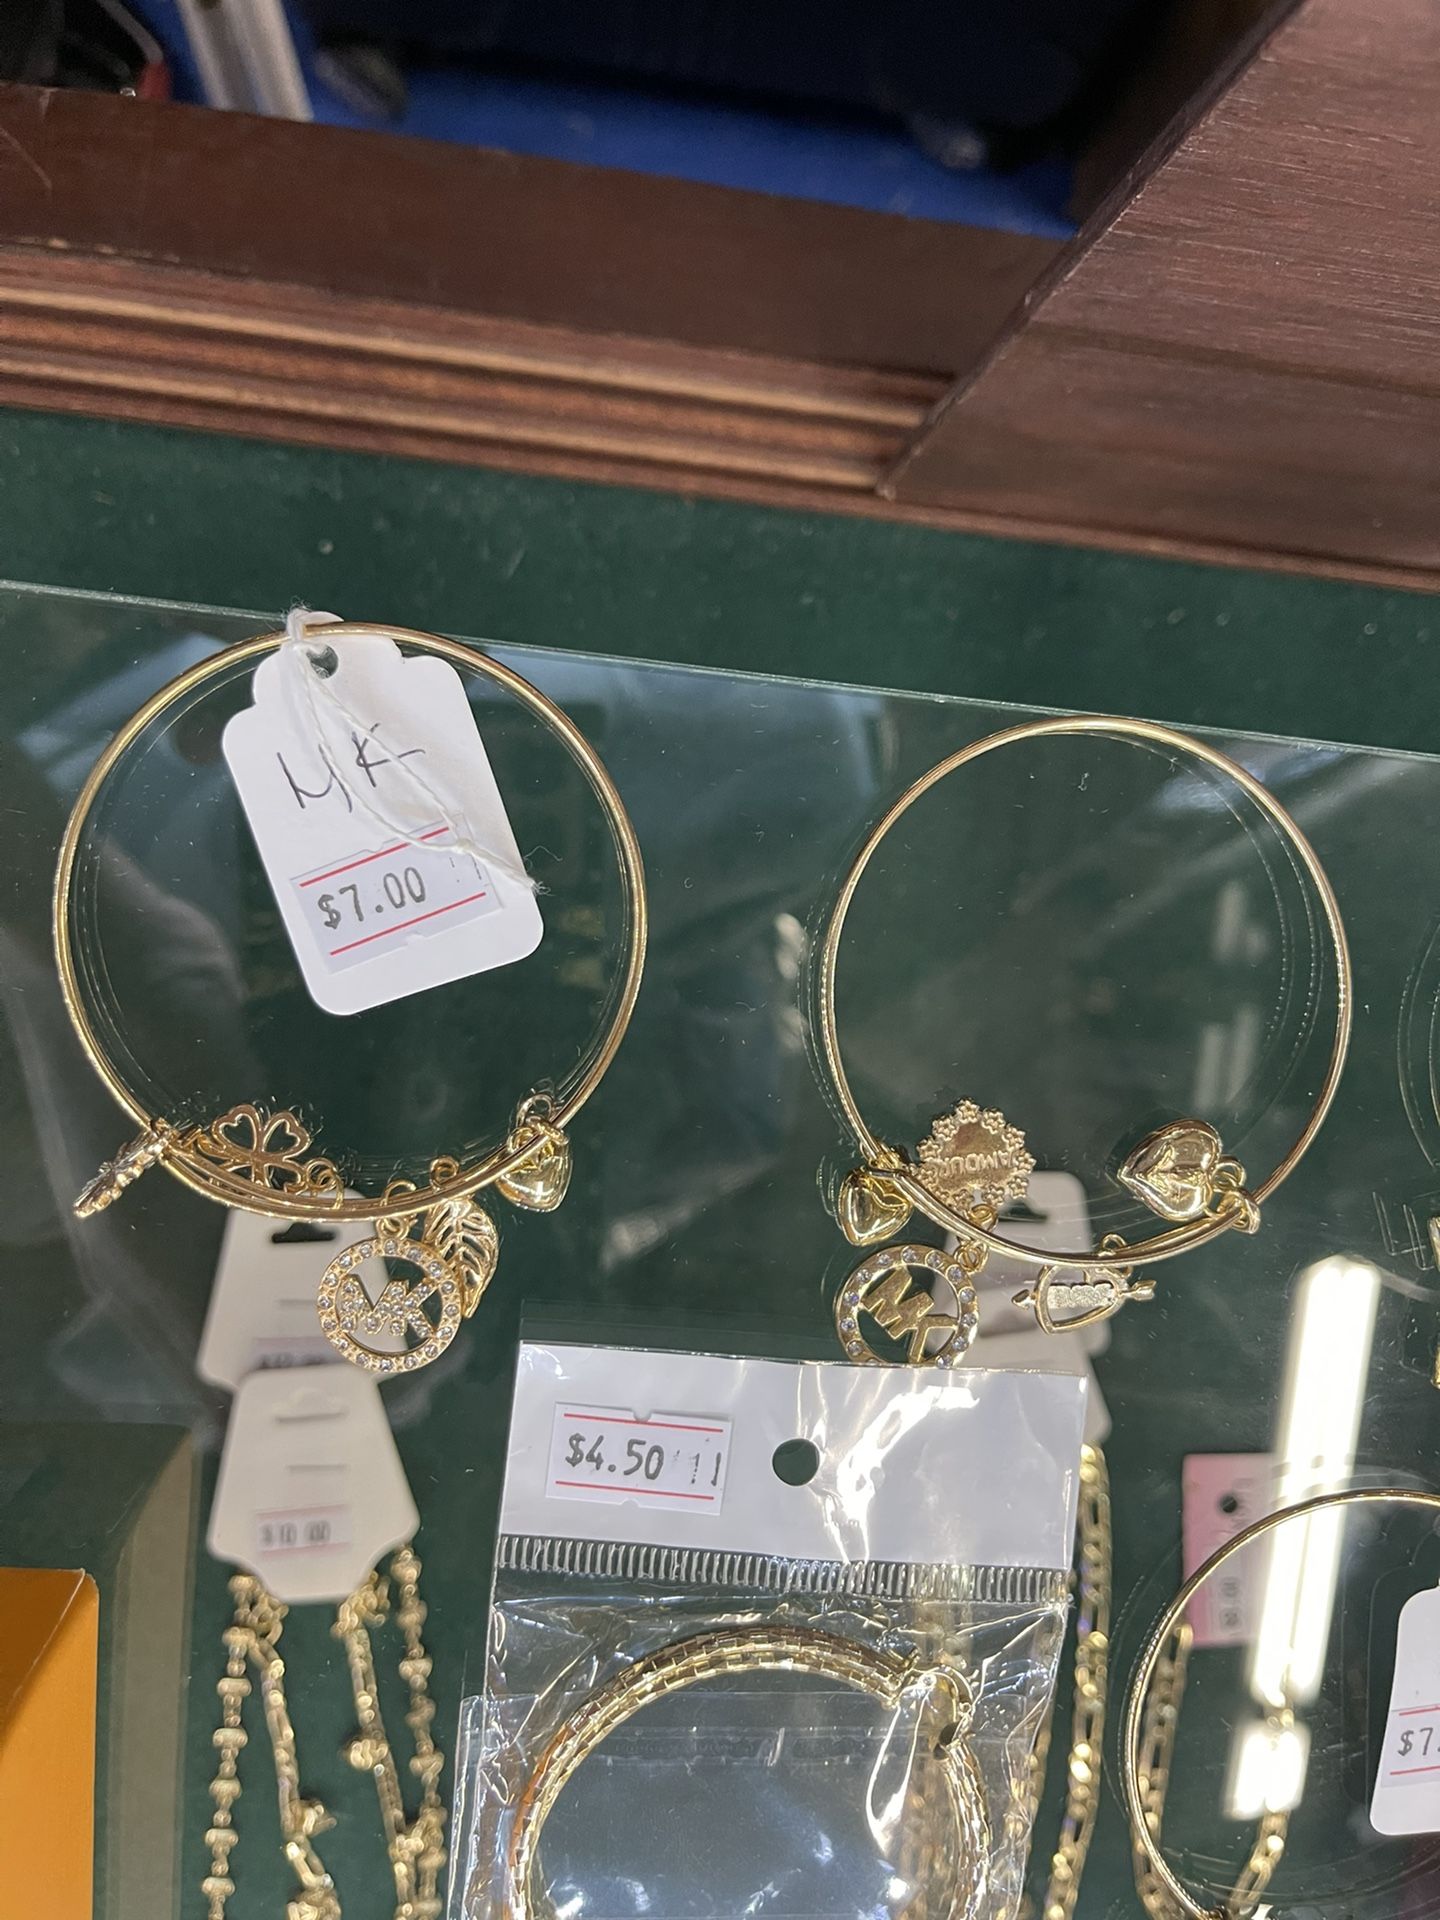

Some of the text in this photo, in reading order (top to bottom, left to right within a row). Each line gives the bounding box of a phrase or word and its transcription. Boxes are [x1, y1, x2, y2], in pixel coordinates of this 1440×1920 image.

[277, 722, 426, 812] MK
[316, 865, 427, 930] $7.00
[340, 1273, 438, 1337] MK
[564, 1432, 665, 1481] $4.50
